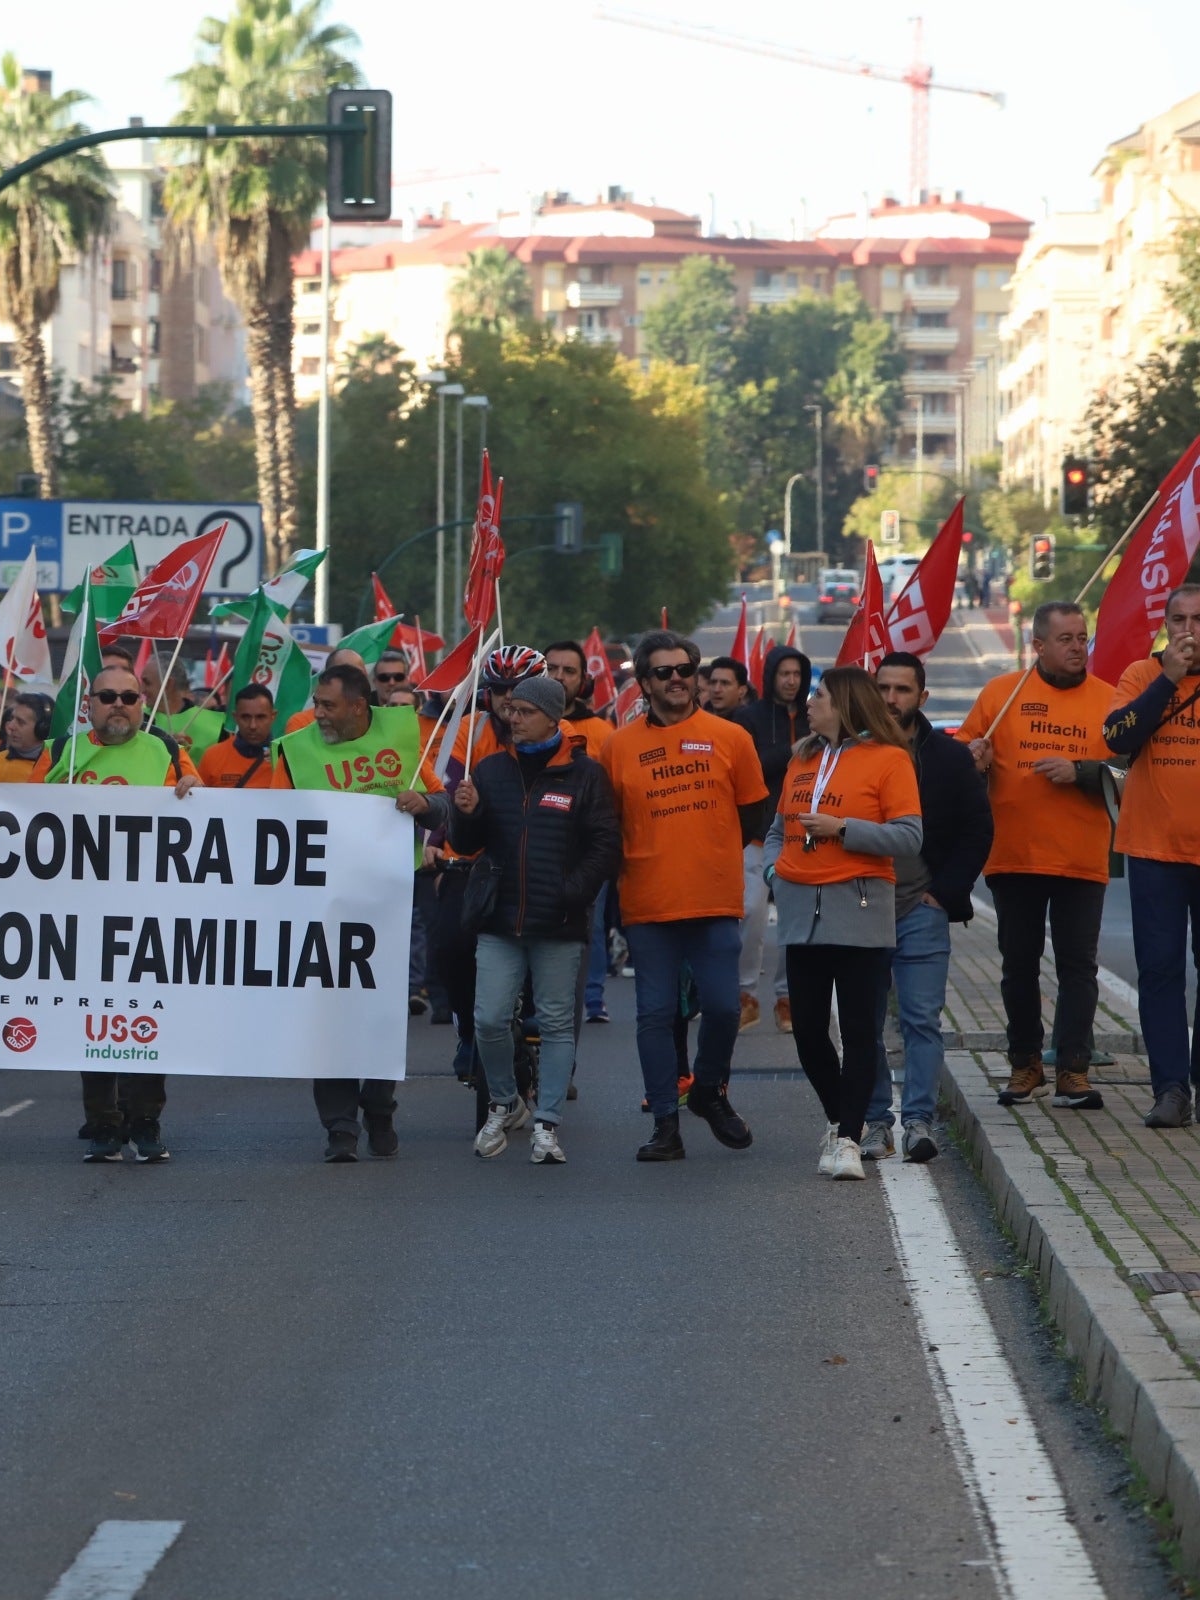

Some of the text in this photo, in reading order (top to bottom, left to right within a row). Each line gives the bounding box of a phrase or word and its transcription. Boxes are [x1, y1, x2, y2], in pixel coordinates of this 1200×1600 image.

[68, 513, 189, 537] ENTRADA
[1030, 721, 1087, 739] Hitachi
[1020, 740, 1065, 751] Negociar
[325, 749, 402, 790] USO
[652, 760, 710, 780] Hitachi
[646, 783, 691, 799] Negociar
[651, 803, 691, 818] Imponer
[693, 800, 709, 810] NO
[254, 818, 328, 886] DE
[101, 916, 377, 989] FAMILIAR
[0, 994, 164, 1010] EMPRESA
[85, 1014, 158, 1044] USO
[85, 1044, 159, 1061] industria
